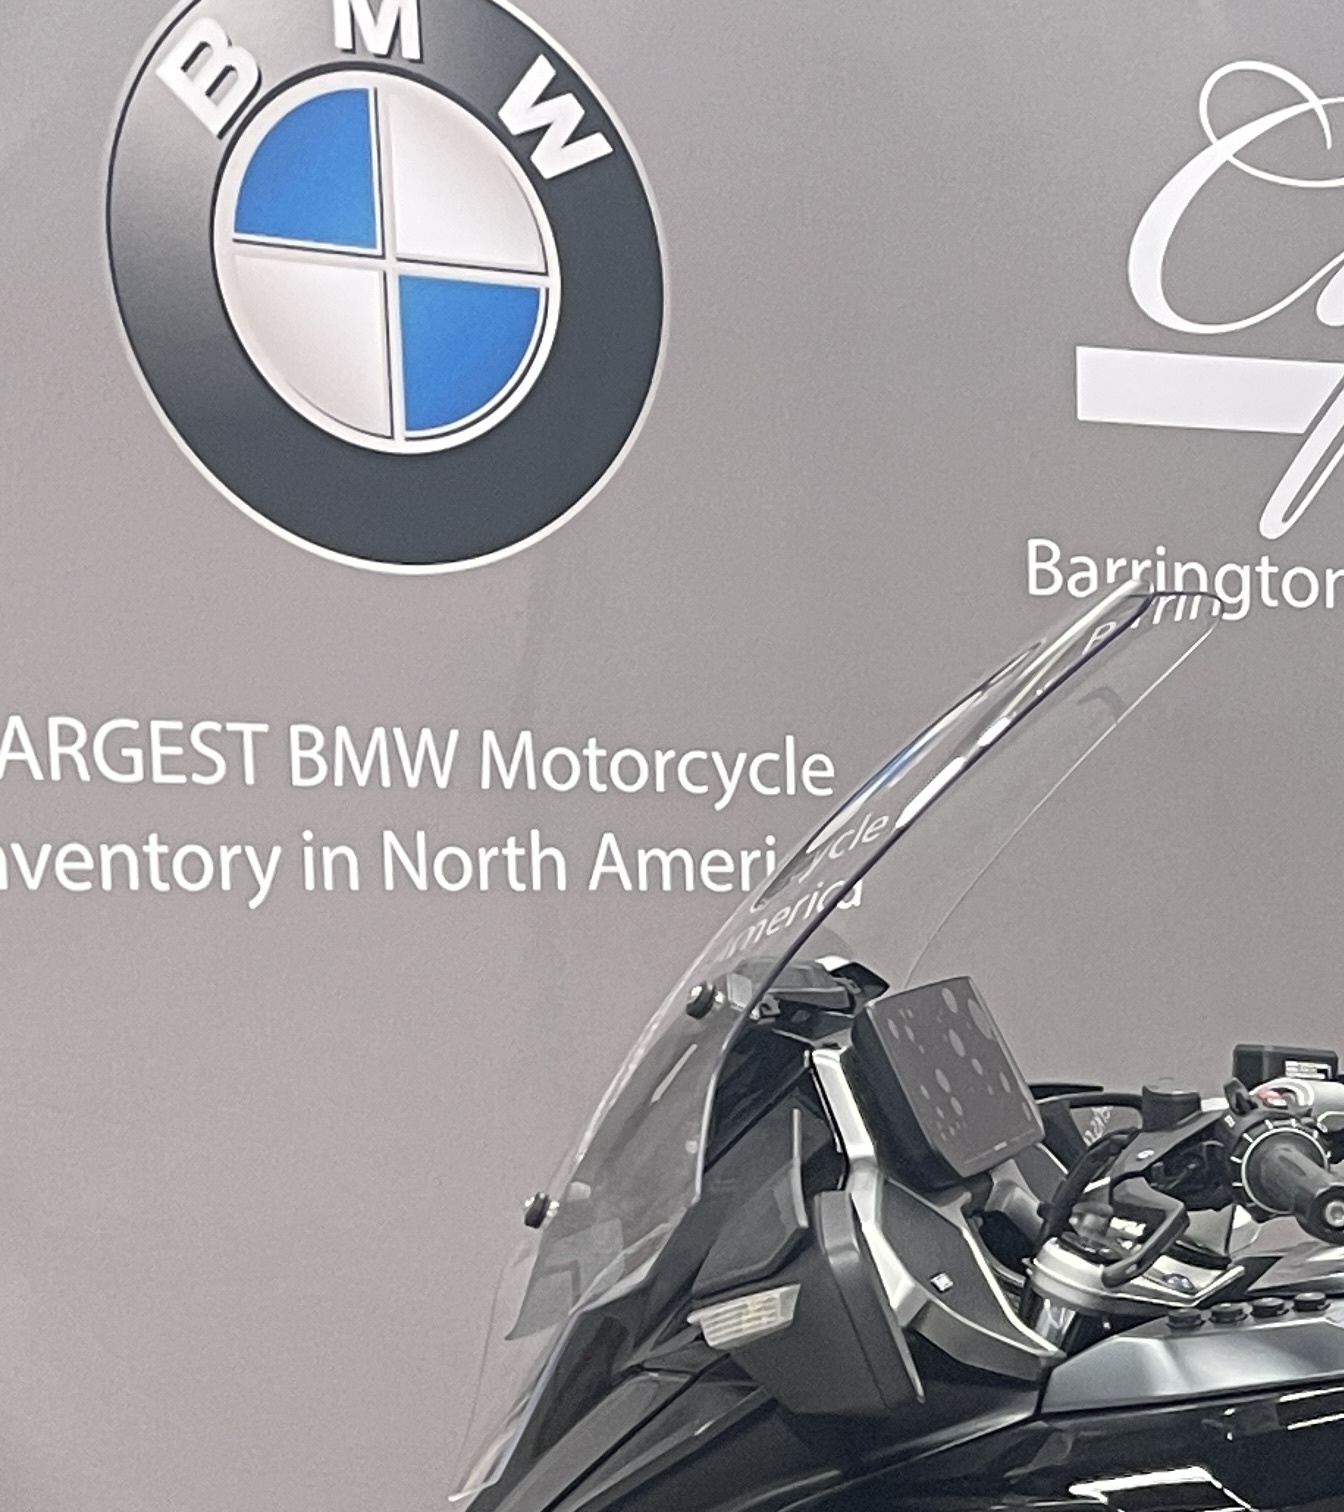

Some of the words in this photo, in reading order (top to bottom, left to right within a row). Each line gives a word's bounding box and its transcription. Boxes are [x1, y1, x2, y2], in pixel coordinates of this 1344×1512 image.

[155, 0, 614, 180] BMW
[288, 723, 459, 790] BMW
[481, 729, 836, 811] Motorcycle
[302, 829, 360, 892] in
[382, 828, 568, 893] North
